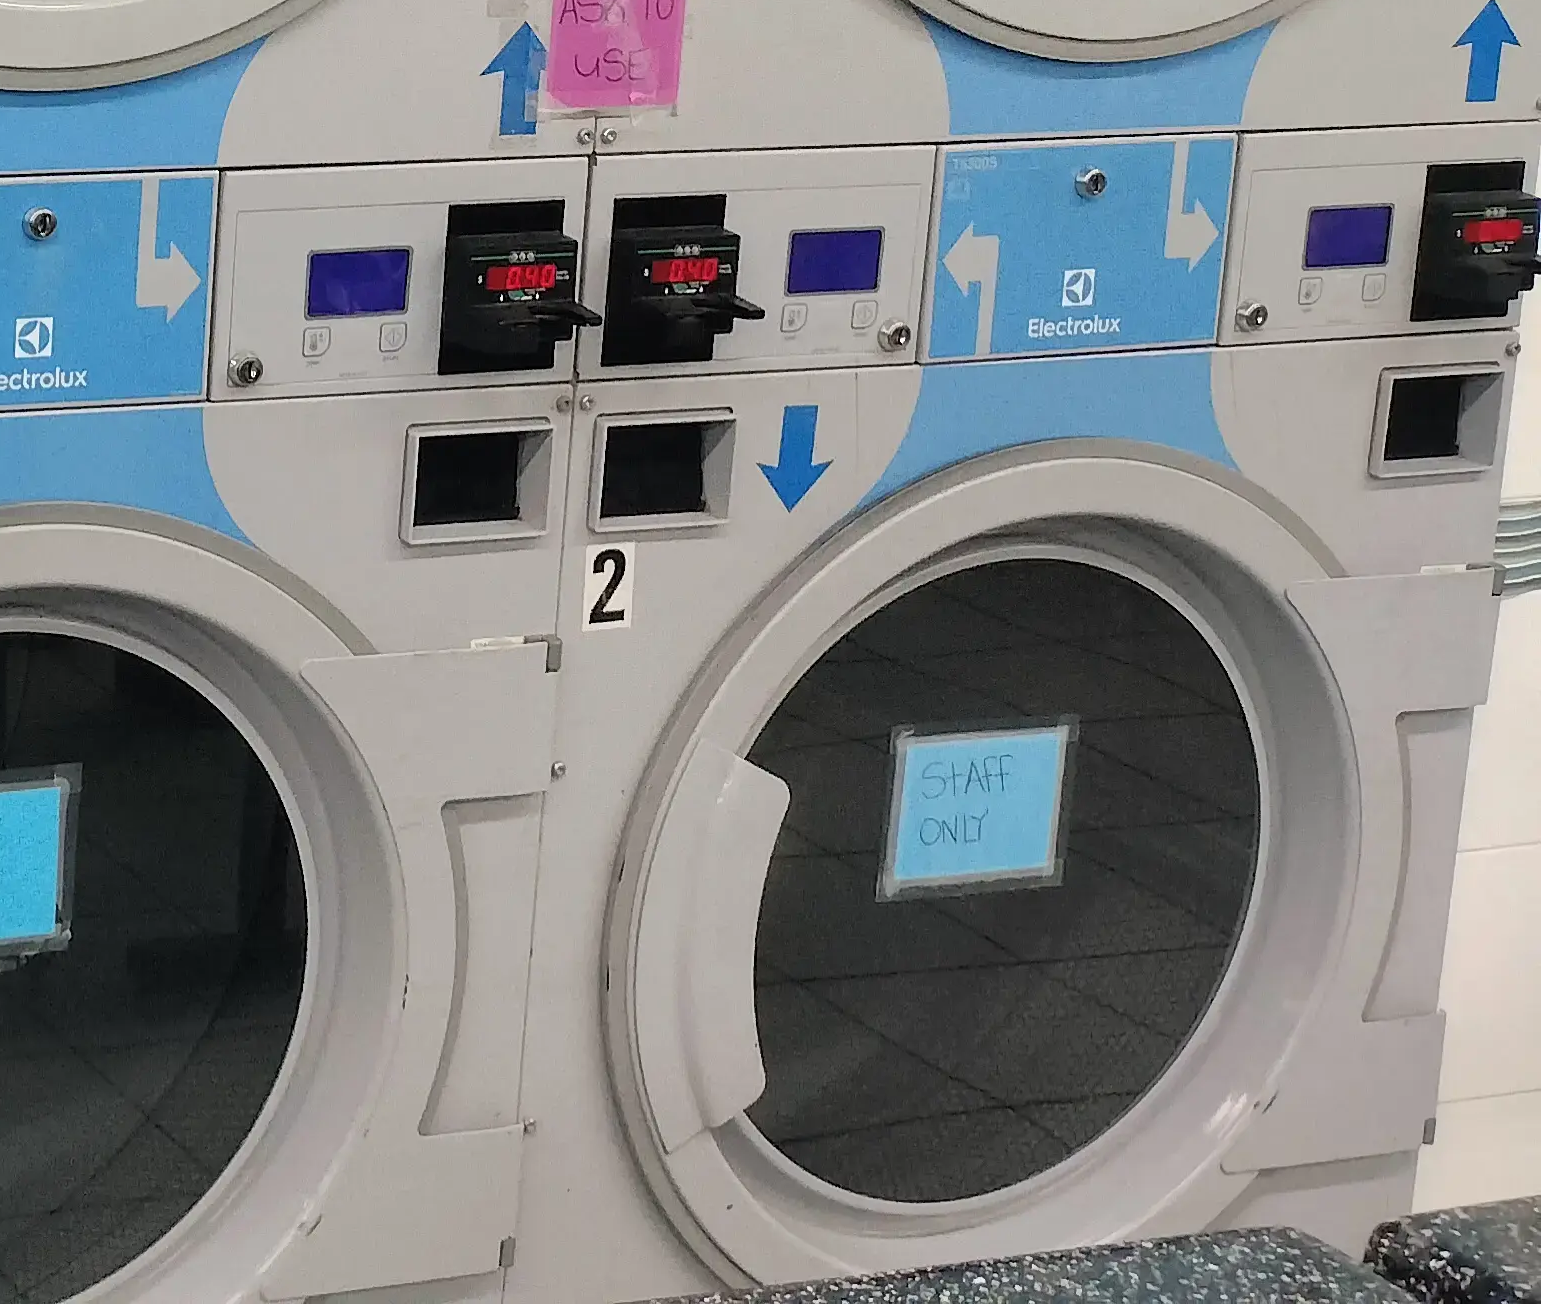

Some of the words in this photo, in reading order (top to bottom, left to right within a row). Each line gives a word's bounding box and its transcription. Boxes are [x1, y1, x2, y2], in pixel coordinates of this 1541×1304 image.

[574, 48, 650, 82] USE
[1028, 315, 1121, 339] Electrolux
[588, 548, 626, 625] 2
[919, 806, 989, 846] ONLY
